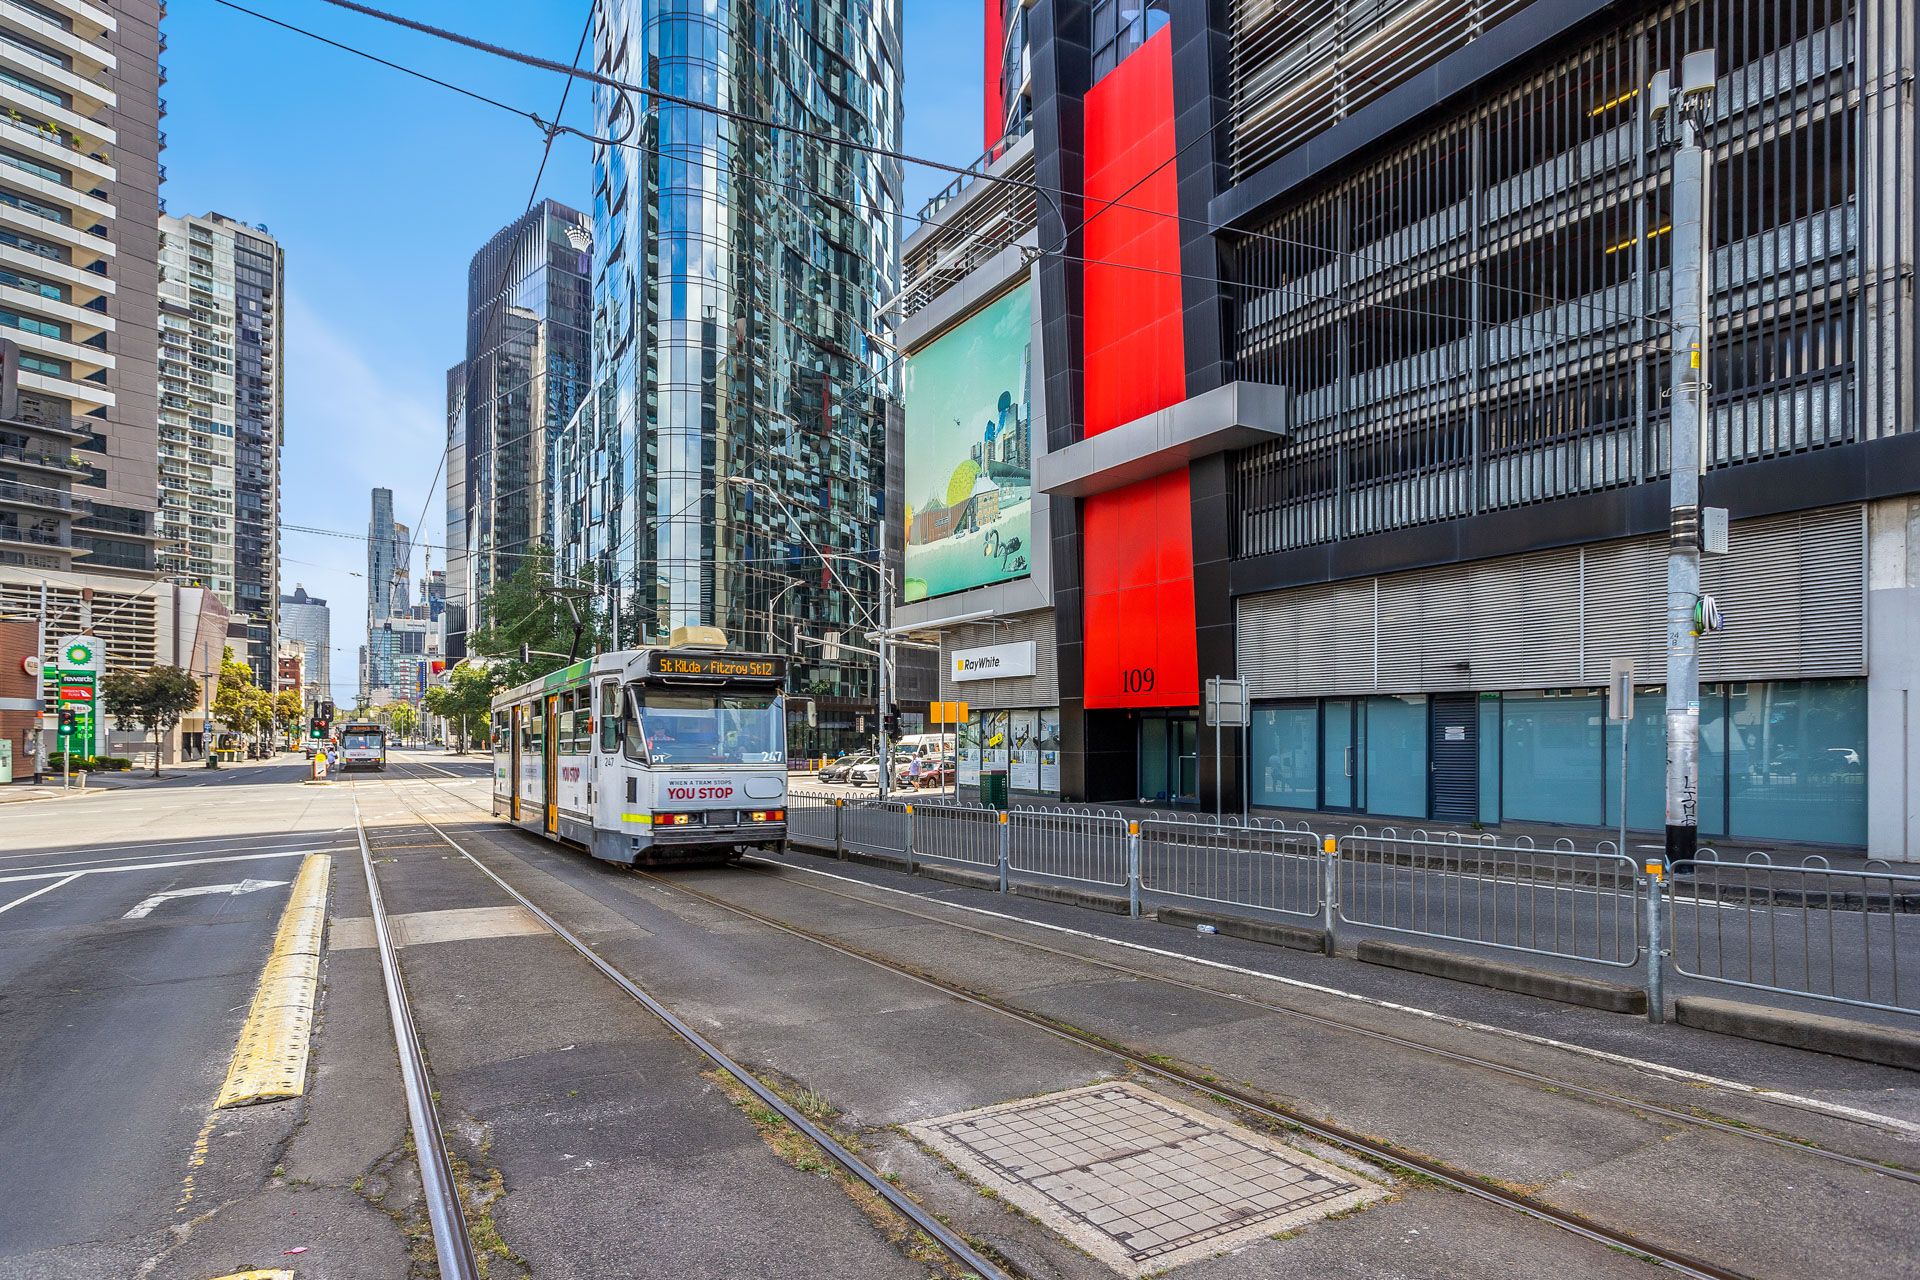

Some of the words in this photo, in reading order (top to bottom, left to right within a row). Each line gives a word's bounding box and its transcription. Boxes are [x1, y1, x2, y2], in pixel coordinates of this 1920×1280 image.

[660, 658, 672, 672] St
[675, 659, 701, 673] Kilda
[710, 661, 748, 675] Fitzroy
[1122, 667, 1155, 693] 109
[604, 757, 615, 767] 247
[761, 751, 783, 762] 247
[668, 787, 695, 799] YOU
[699, 787, 733, 799] STOP
